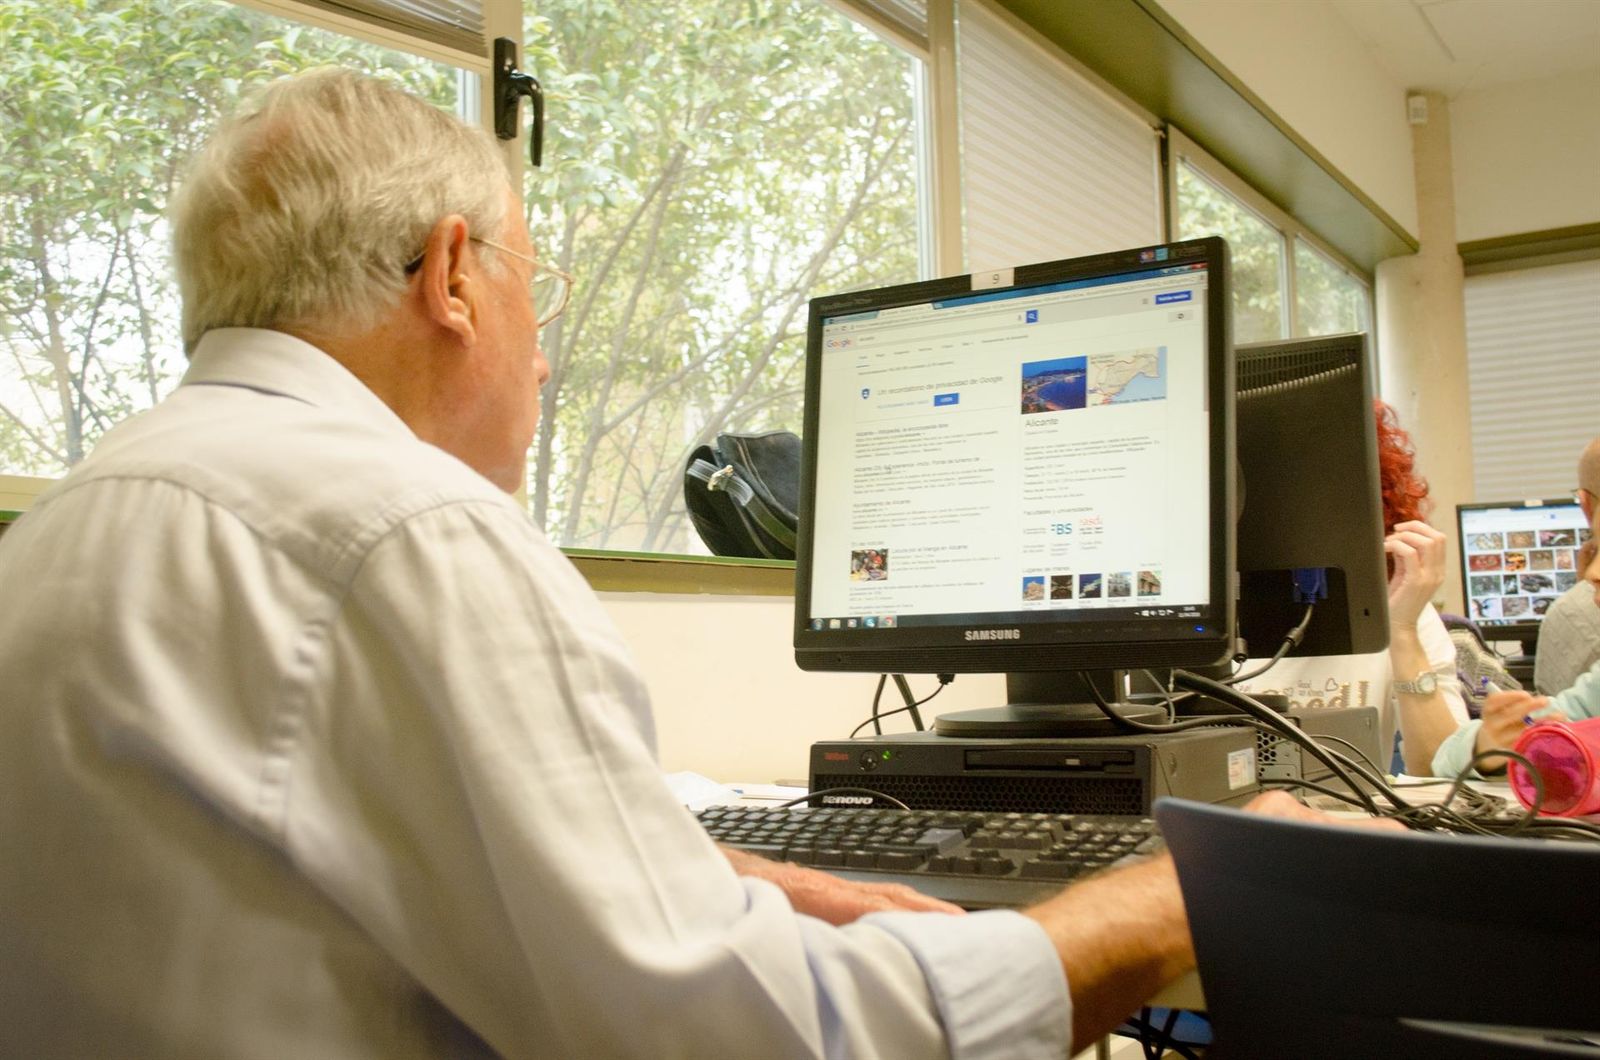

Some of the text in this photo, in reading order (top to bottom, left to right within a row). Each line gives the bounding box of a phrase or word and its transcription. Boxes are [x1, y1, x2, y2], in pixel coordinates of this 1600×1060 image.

[992, 274, 1000, 284] 9
[826, 338, 852, 349] Google
[980, 375, 1003, 385] Google
[1024, 417, 1059, 427] Alicante
[964, 628, 1021, 641] SAMSUNG
[822, 795, 874, 805] lenovo
